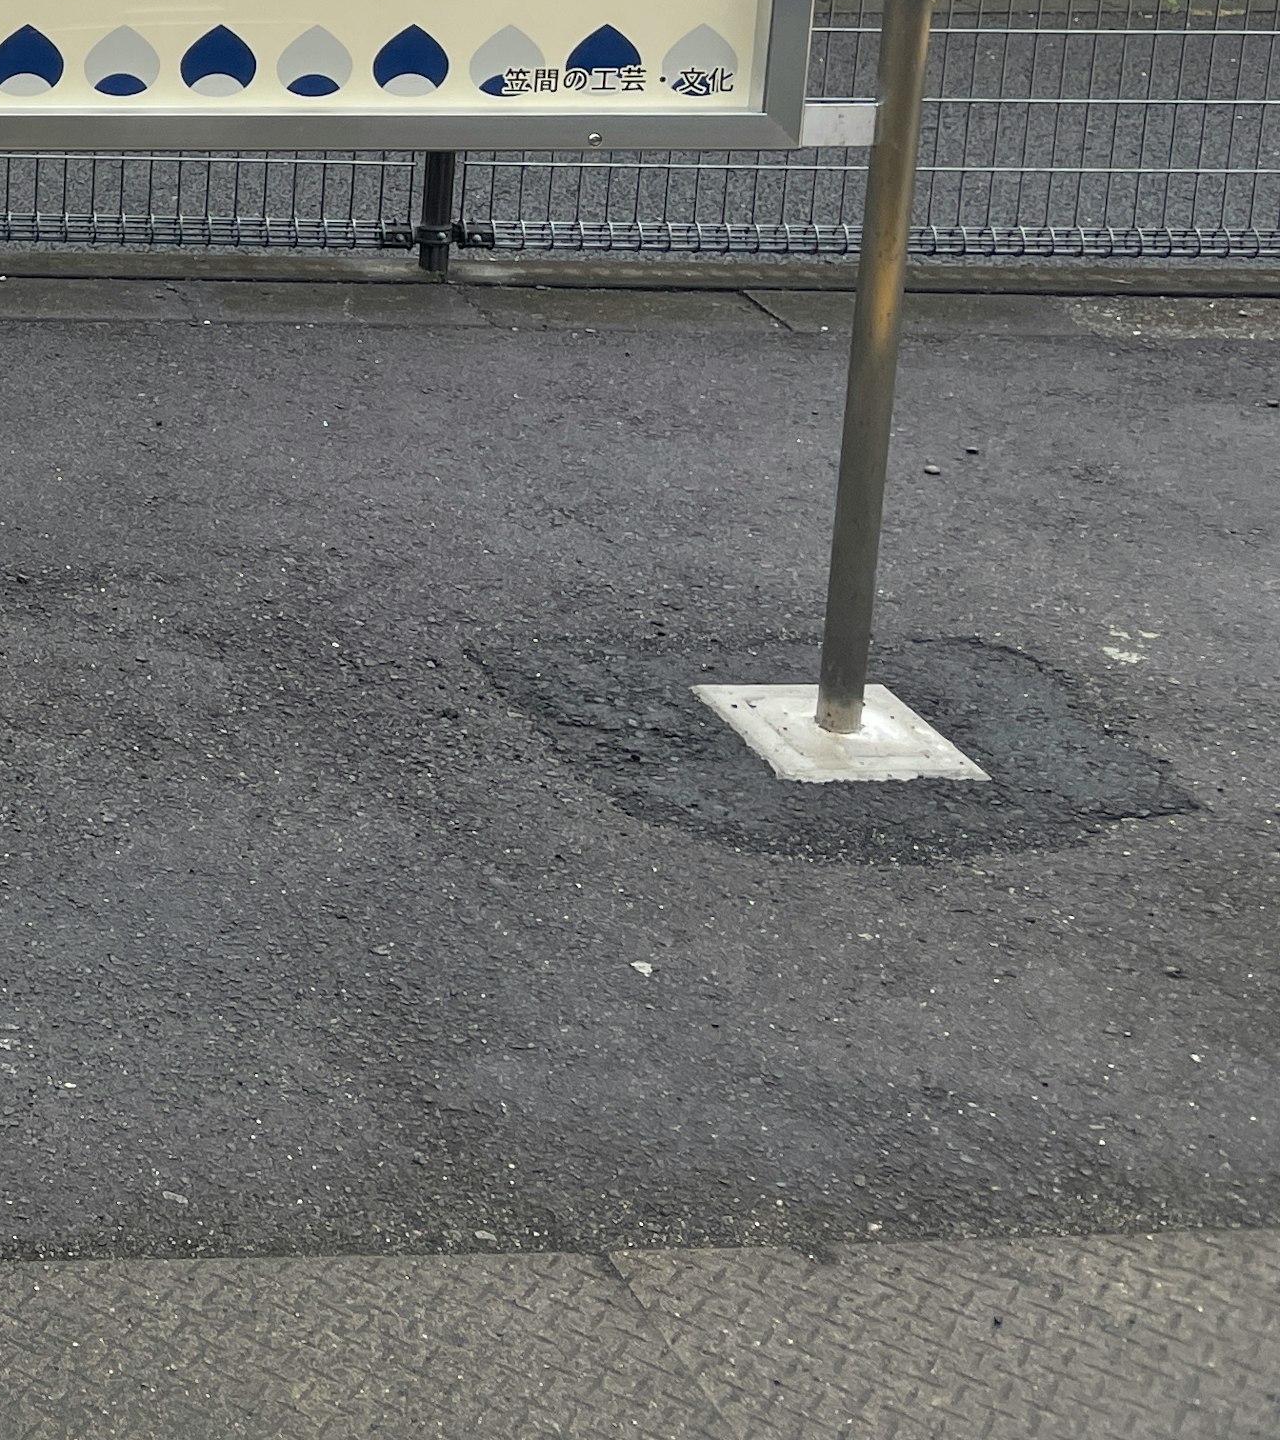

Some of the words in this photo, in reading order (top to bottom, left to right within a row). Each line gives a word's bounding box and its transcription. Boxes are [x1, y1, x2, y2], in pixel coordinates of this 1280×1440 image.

[504, 67, 734, 94] 笠間の工芸・文化
